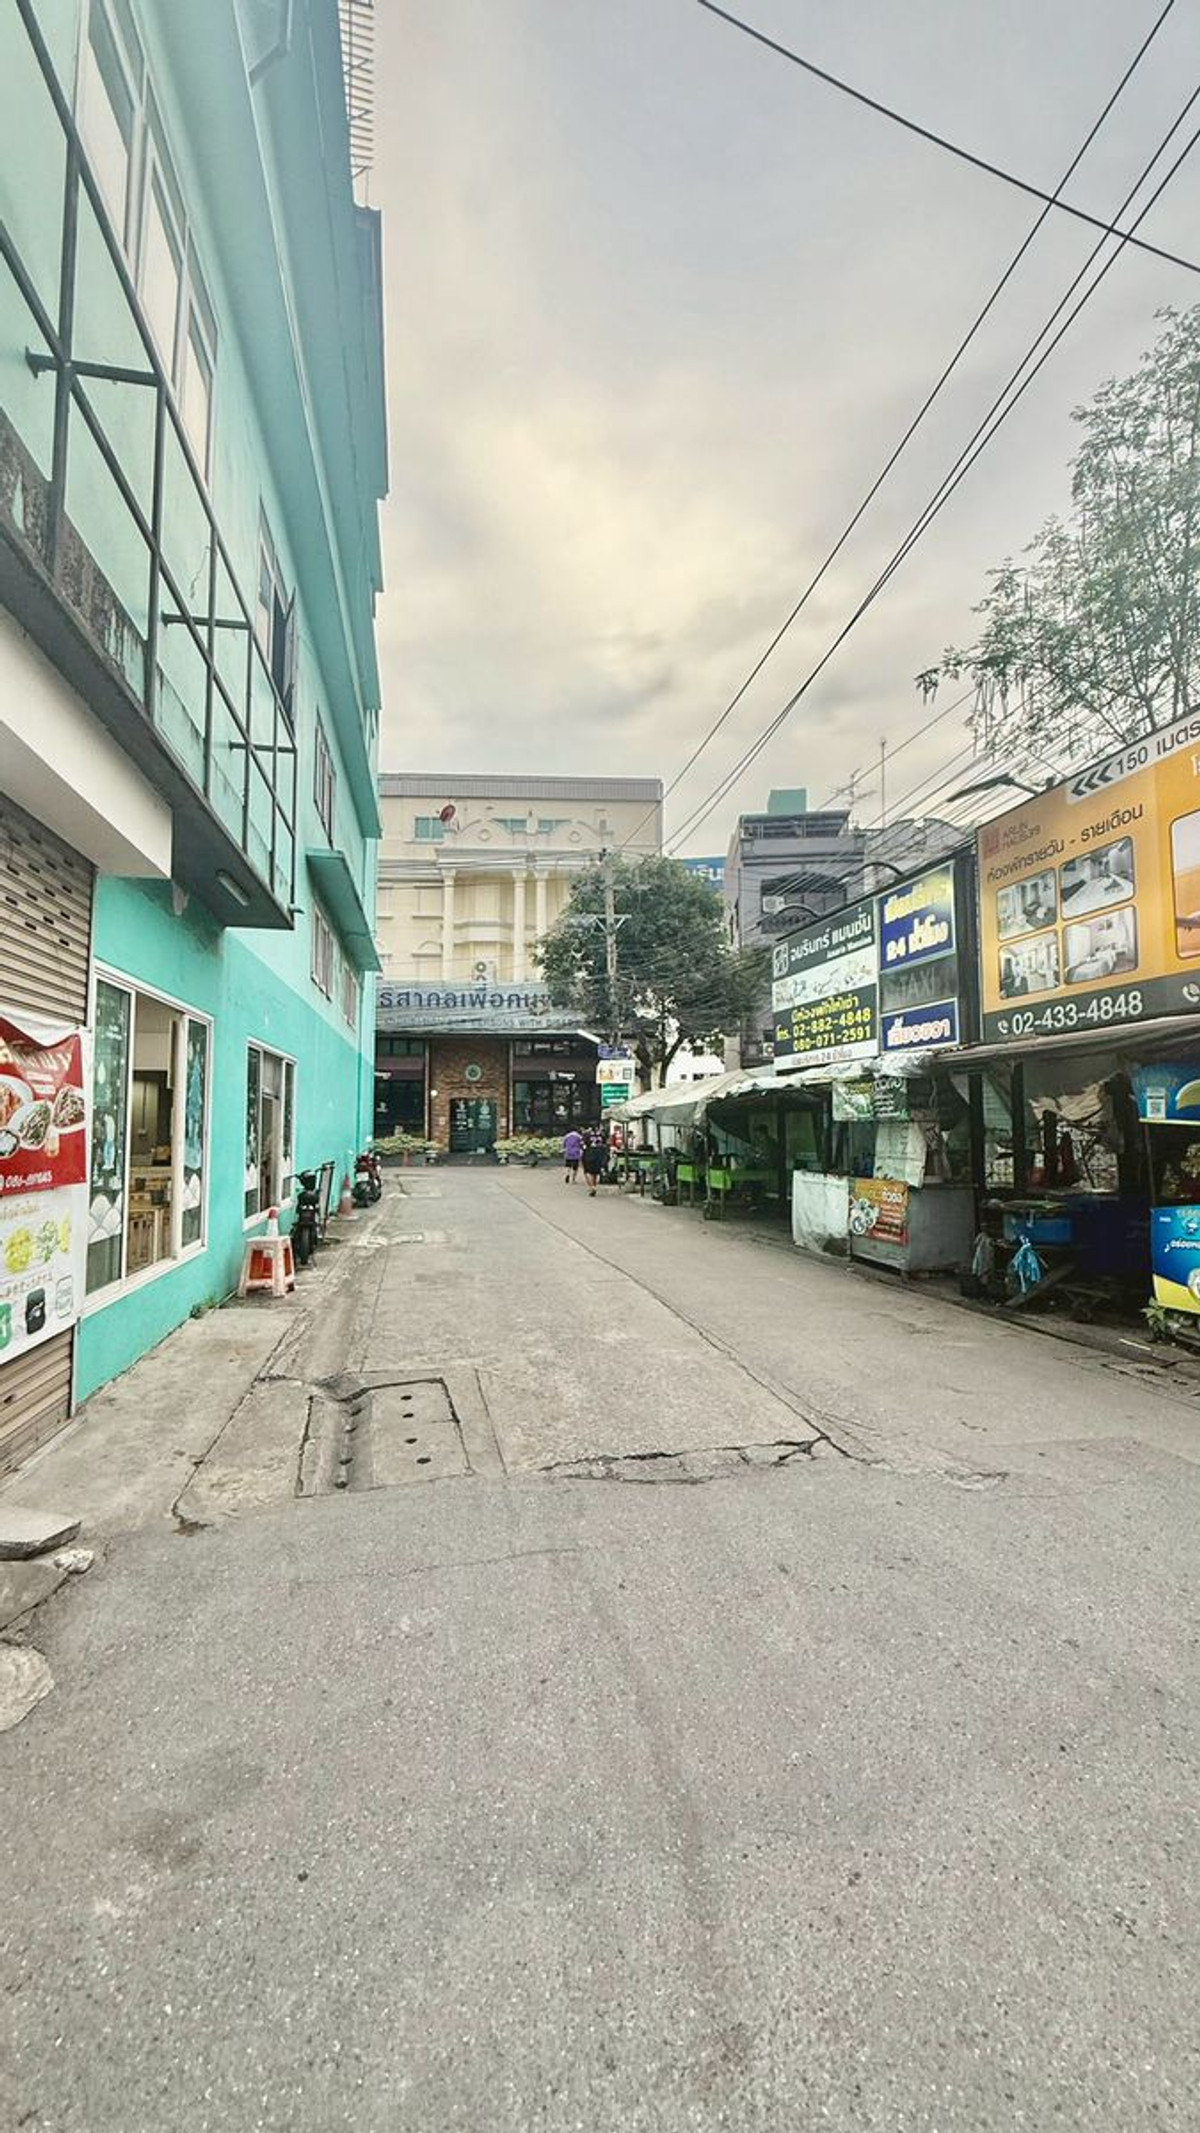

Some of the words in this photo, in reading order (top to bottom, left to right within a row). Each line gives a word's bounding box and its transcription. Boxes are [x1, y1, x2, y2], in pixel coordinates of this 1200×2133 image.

[1116, 746, 1148, 775] 150
[1080, 804, 1144, 843] รายเดือน
[831, 907, 872, 945] แมนชั่น
[886, 939, 906, 961] 24
[899, 967, 935, 1001] TAXI
[793, 1007, 872, 1038] 02-882-4848
[1011, 990, 1144, 1035] 02-433-4848
